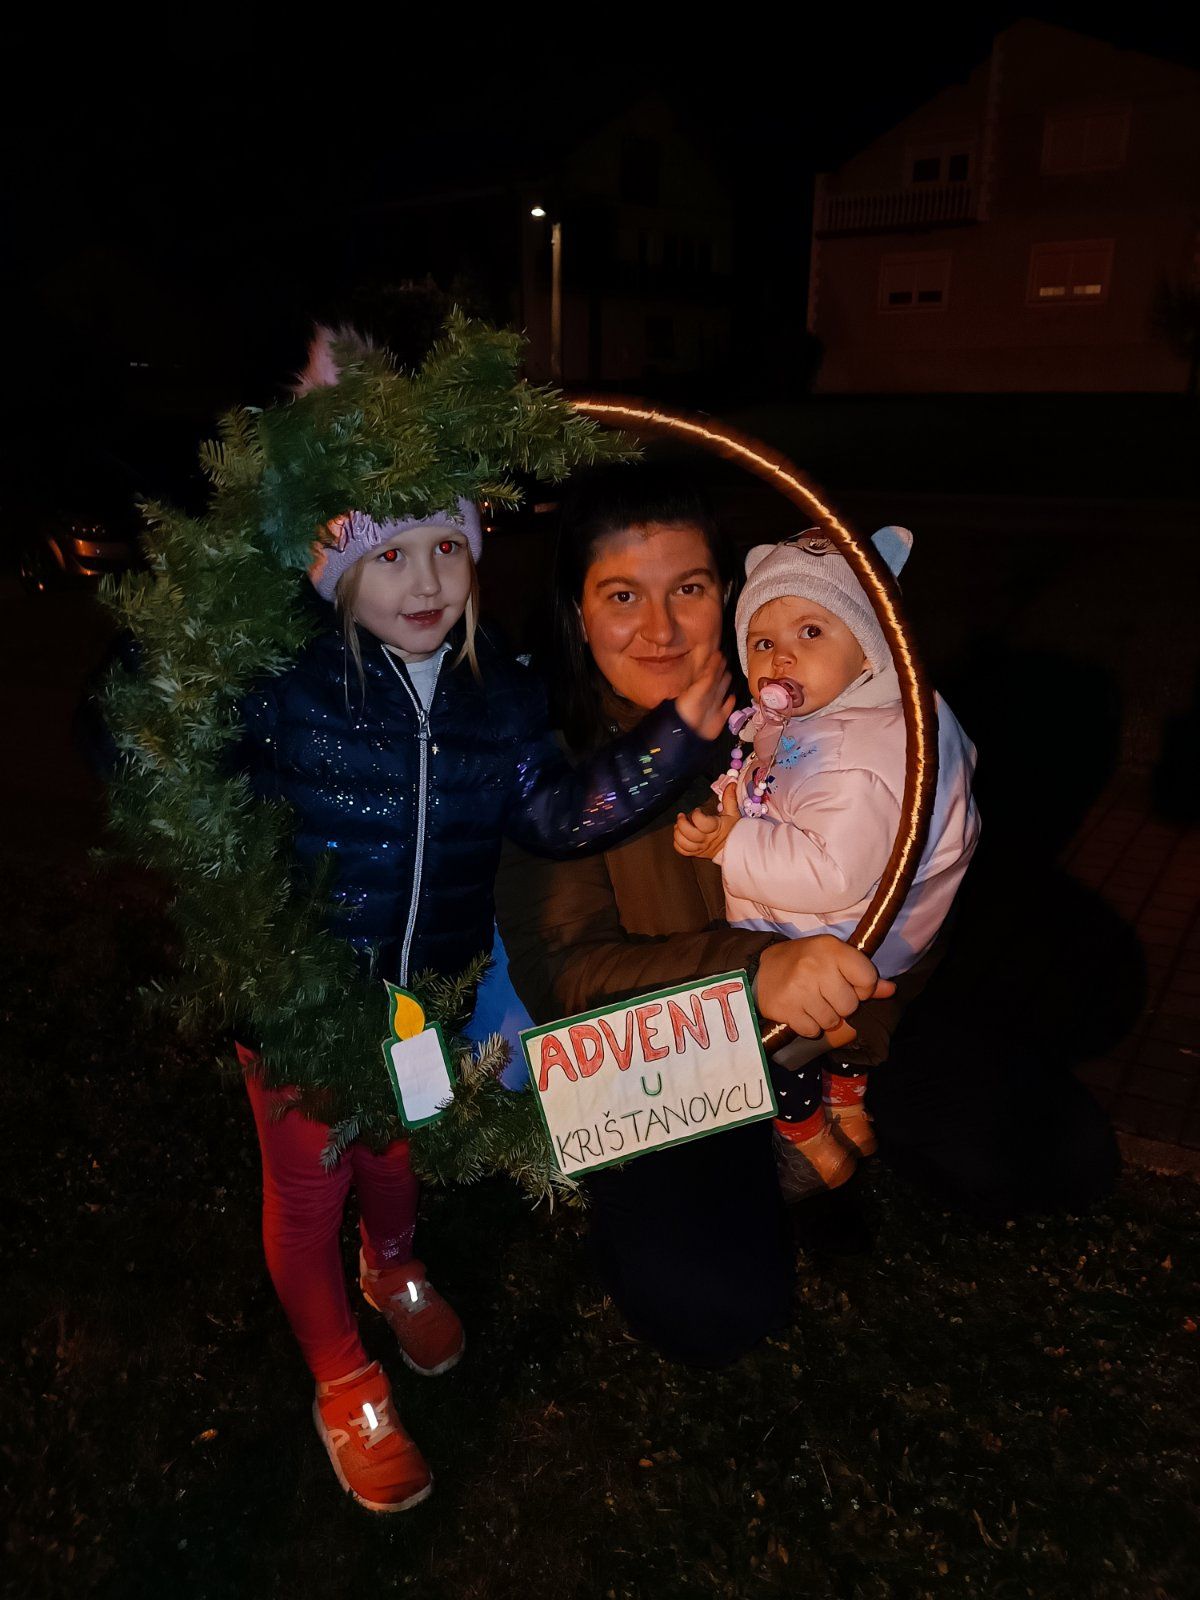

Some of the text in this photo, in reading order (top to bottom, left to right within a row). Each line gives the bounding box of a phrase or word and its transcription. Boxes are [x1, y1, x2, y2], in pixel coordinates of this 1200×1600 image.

[538, 982, 743, 1092] ADVENT
[556, 1079, 764, 1168] KRIŠTANOVCU
[641, 1073, 662, 1096] U
